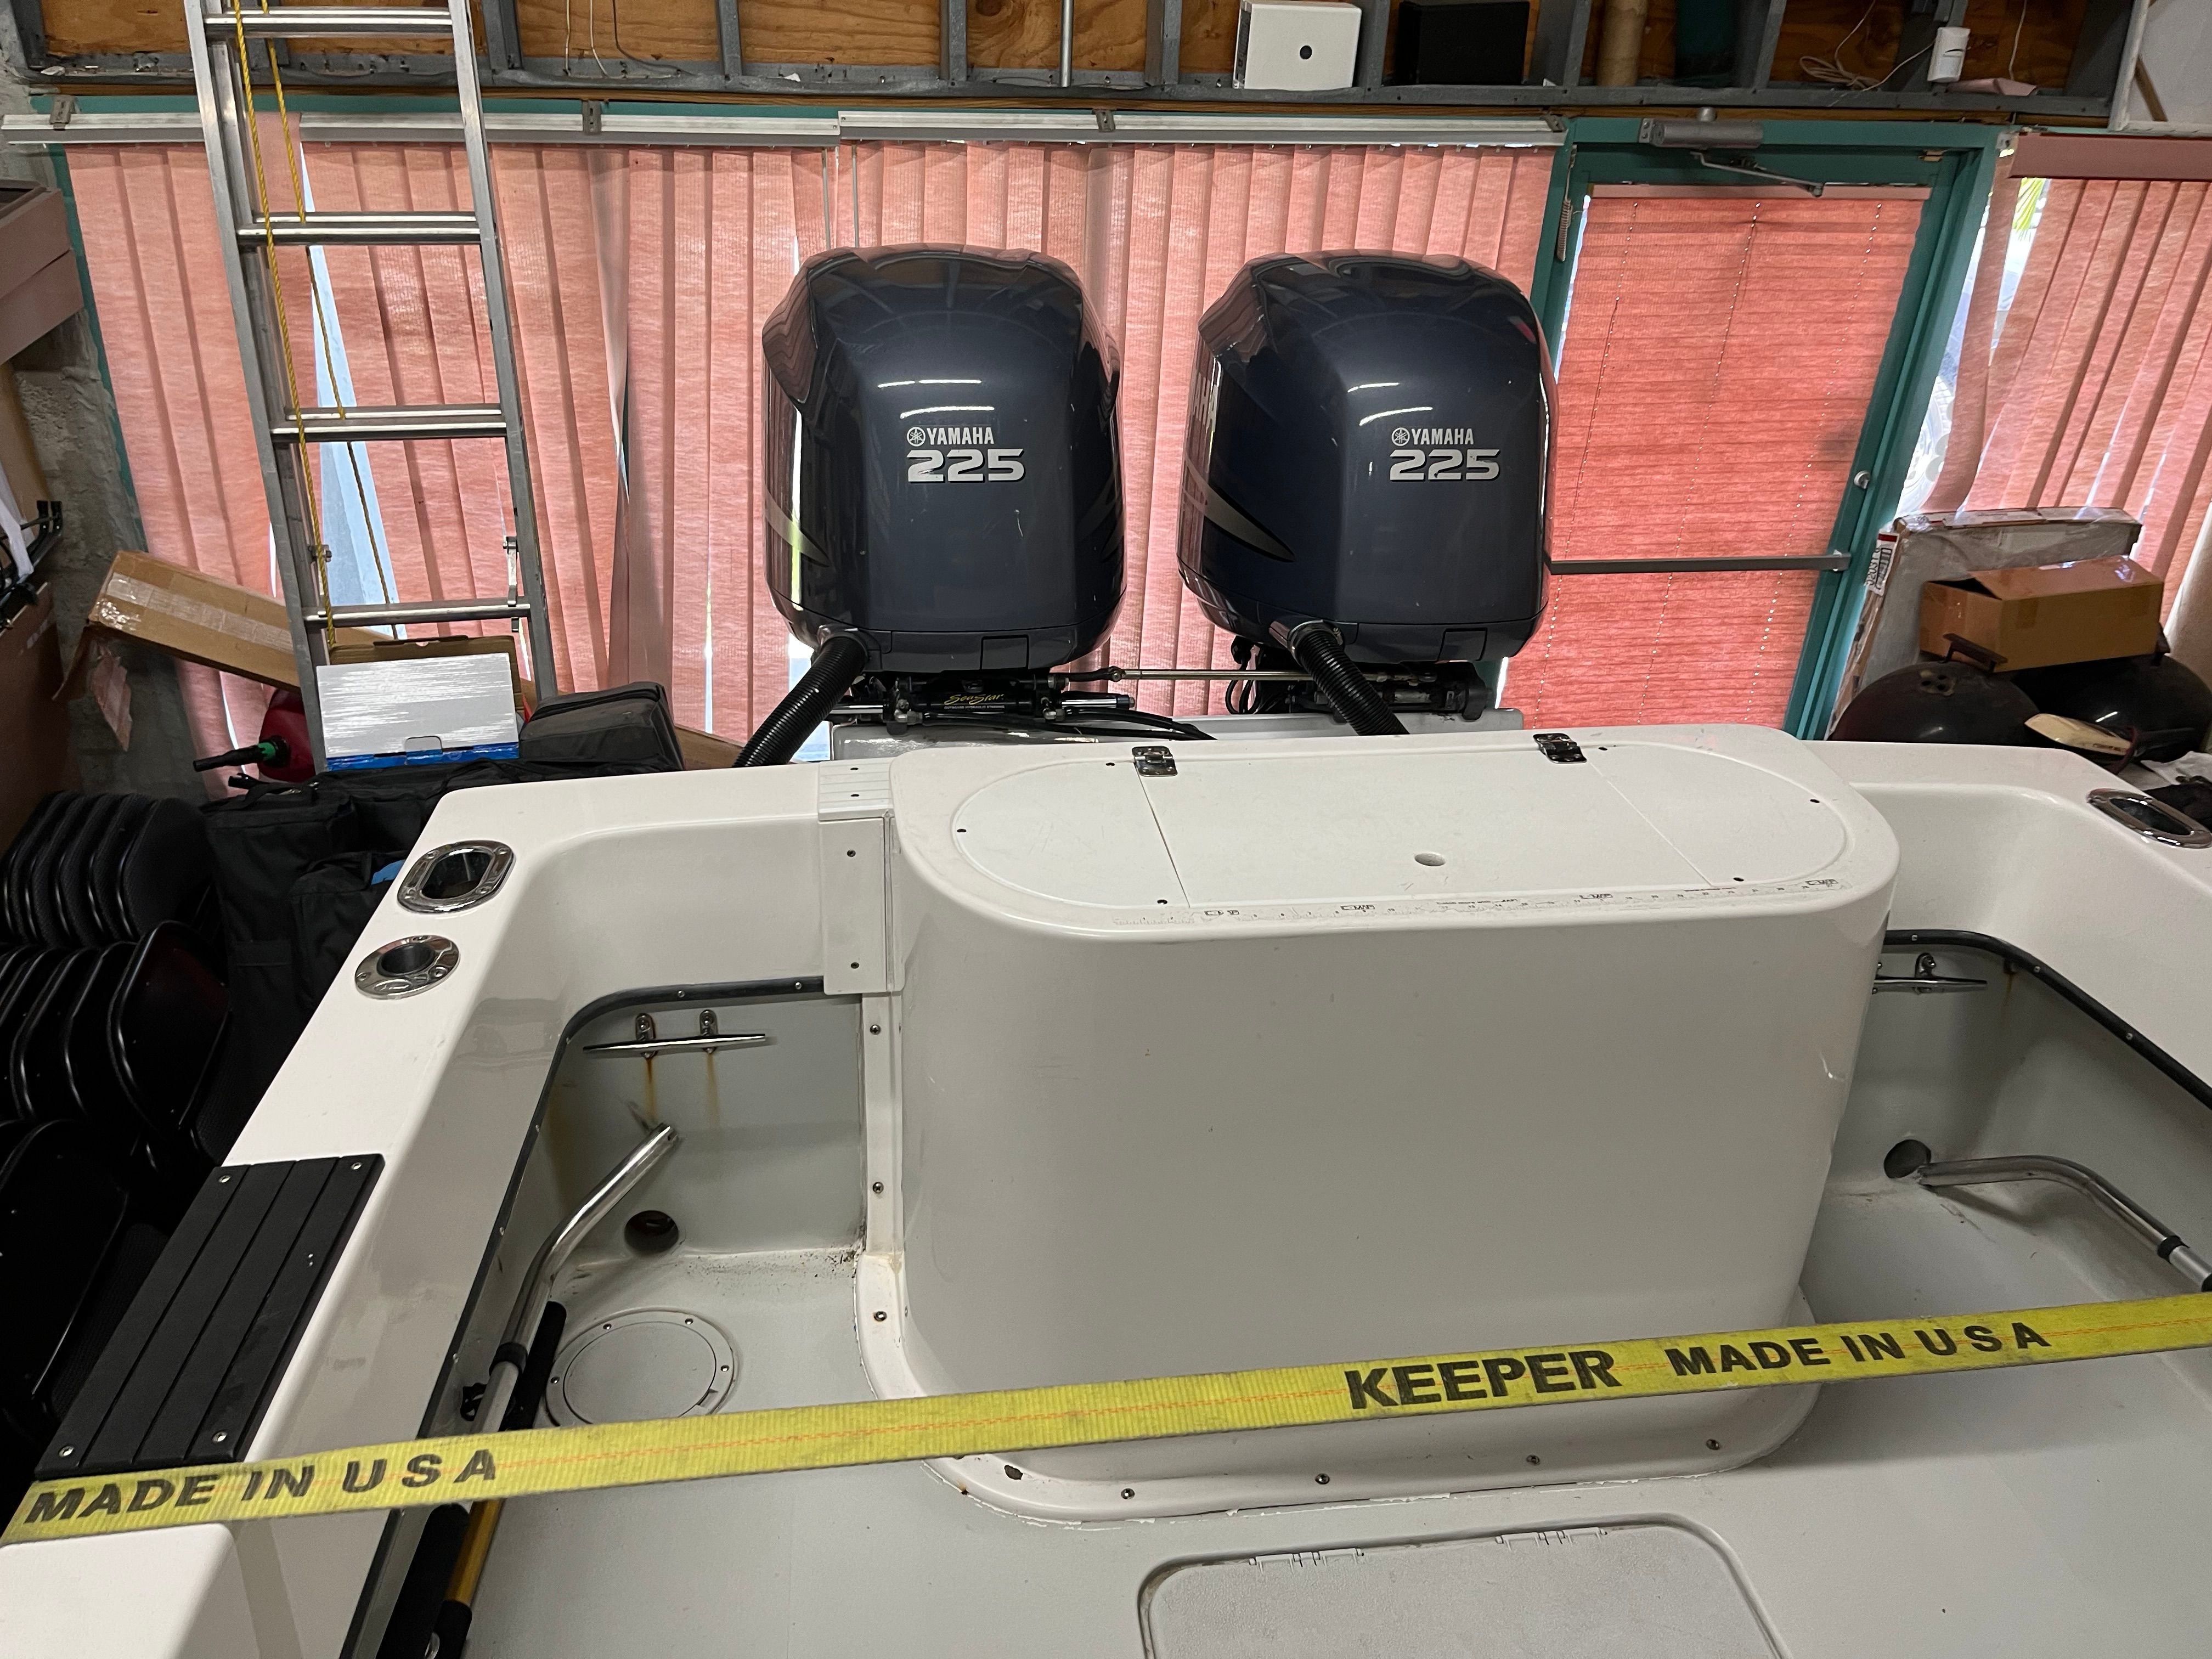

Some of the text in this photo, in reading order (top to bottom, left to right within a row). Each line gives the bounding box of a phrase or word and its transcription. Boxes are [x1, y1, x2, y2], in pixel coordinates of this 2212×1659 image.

[927, 427, 995, 445] YAMAHA
[1411, 428, 1474, 445] YAMAHA
[907, 449, 1025, 482] 225
[1390, 449, 1500, 481] 225
[1344, 1322, 2052, 1409] KEEPER MADE IN USA
[24, 1449, 496, 1523] MADE IN USA
